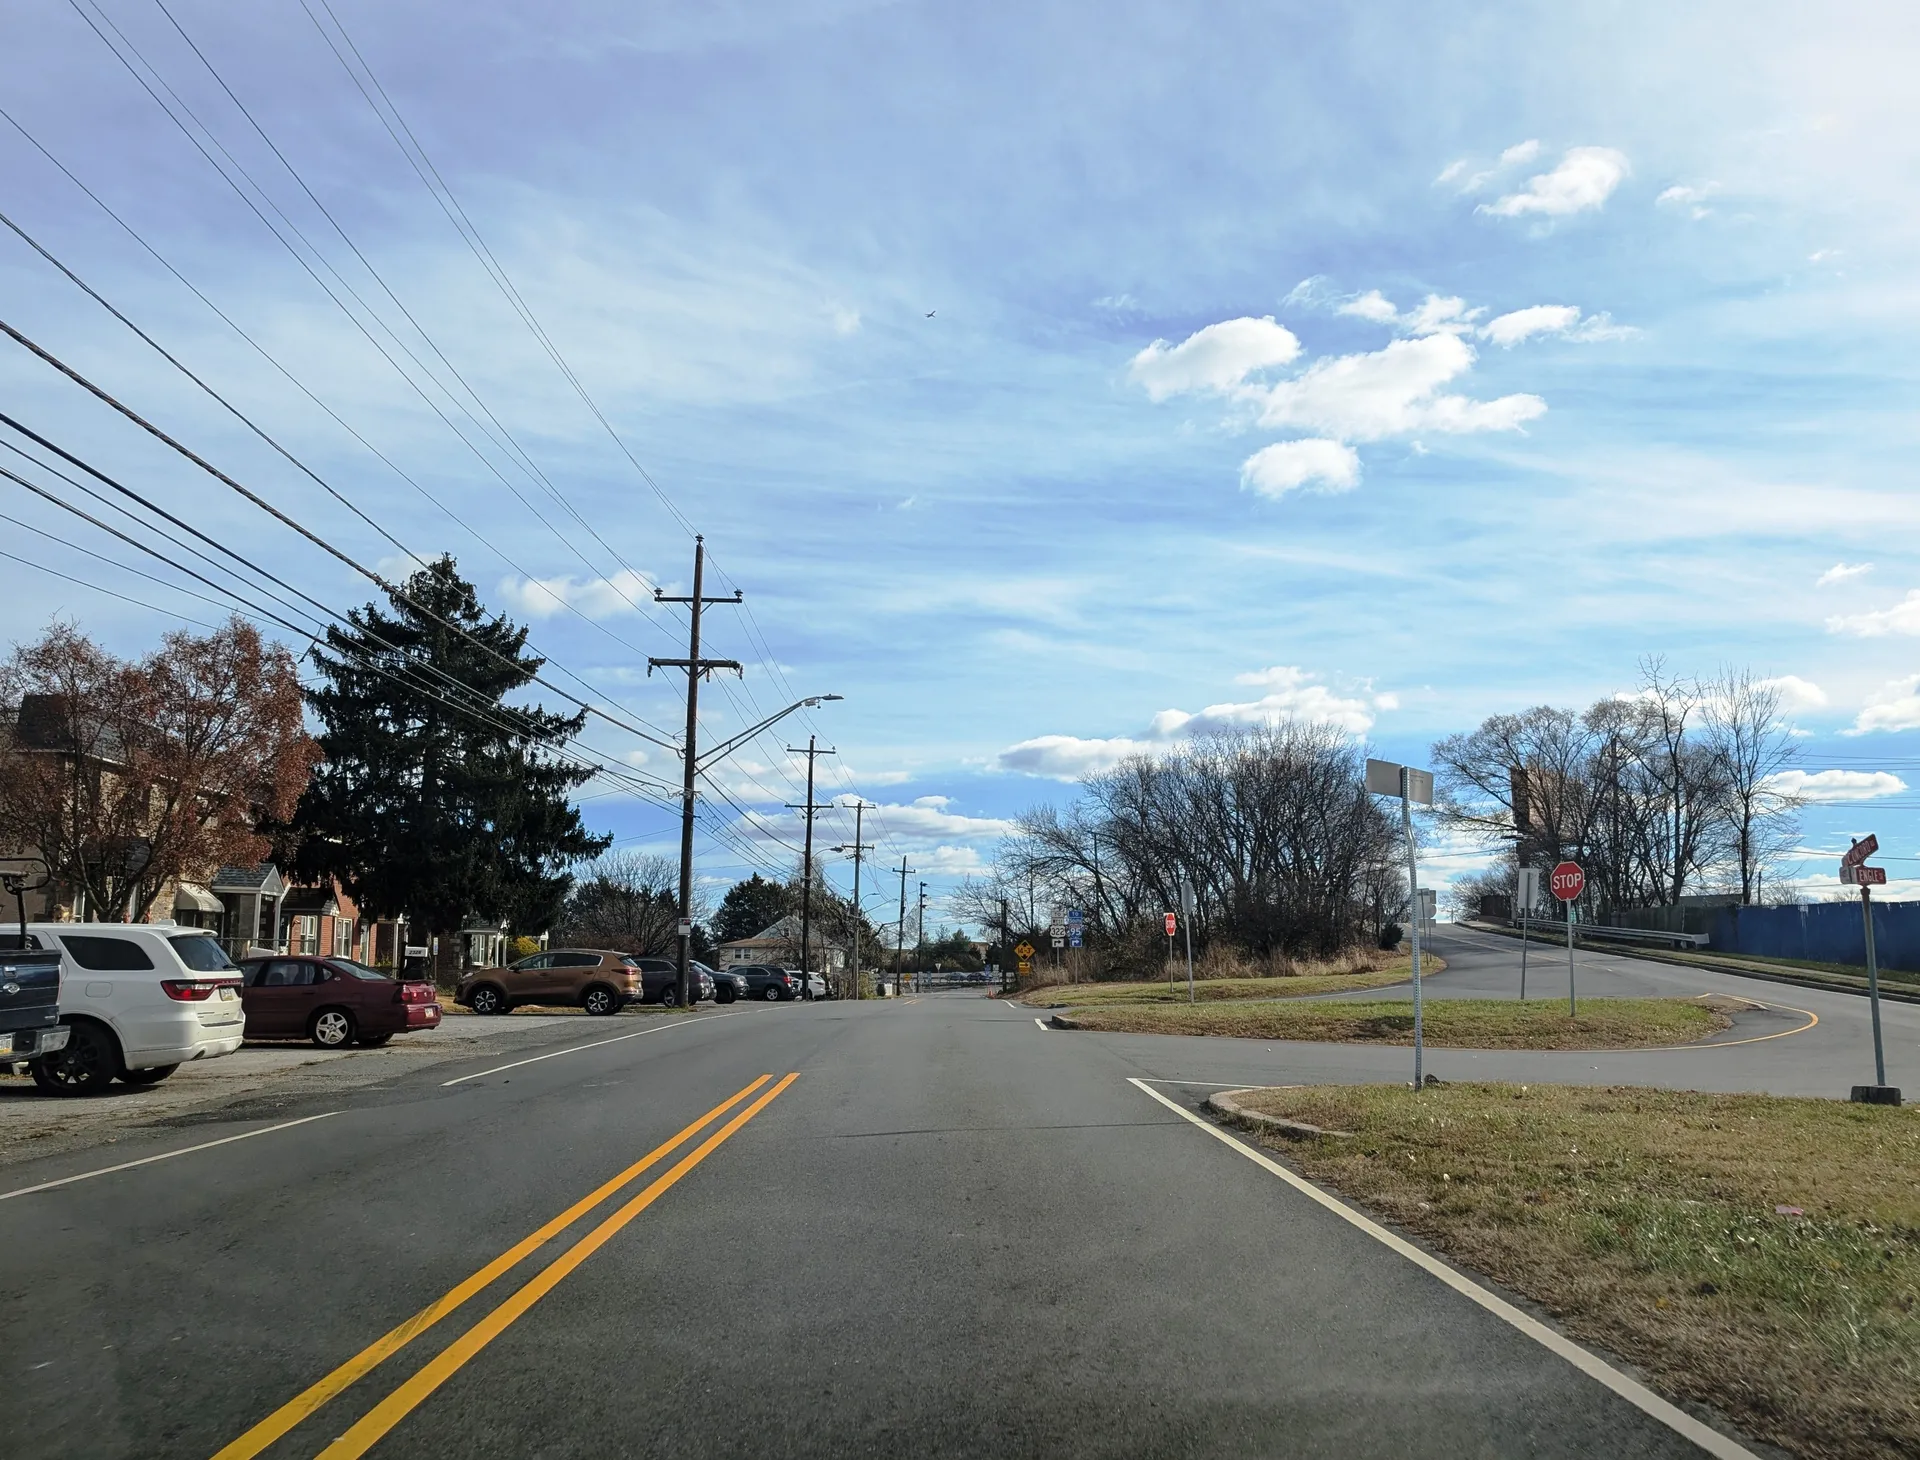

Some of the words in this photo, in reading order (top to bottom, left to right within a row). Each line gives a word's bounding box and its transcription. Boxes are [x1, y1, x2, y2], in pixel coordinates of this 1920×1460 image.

[1848, 840, 1871, 864] CONCORD
[1553, 873, 1581, 889] STOP
[1858, 869, 1878, 882] ENGLE
[1051, 927, 1065, 936] 322
[1070, 927, 1081, 936] 95
